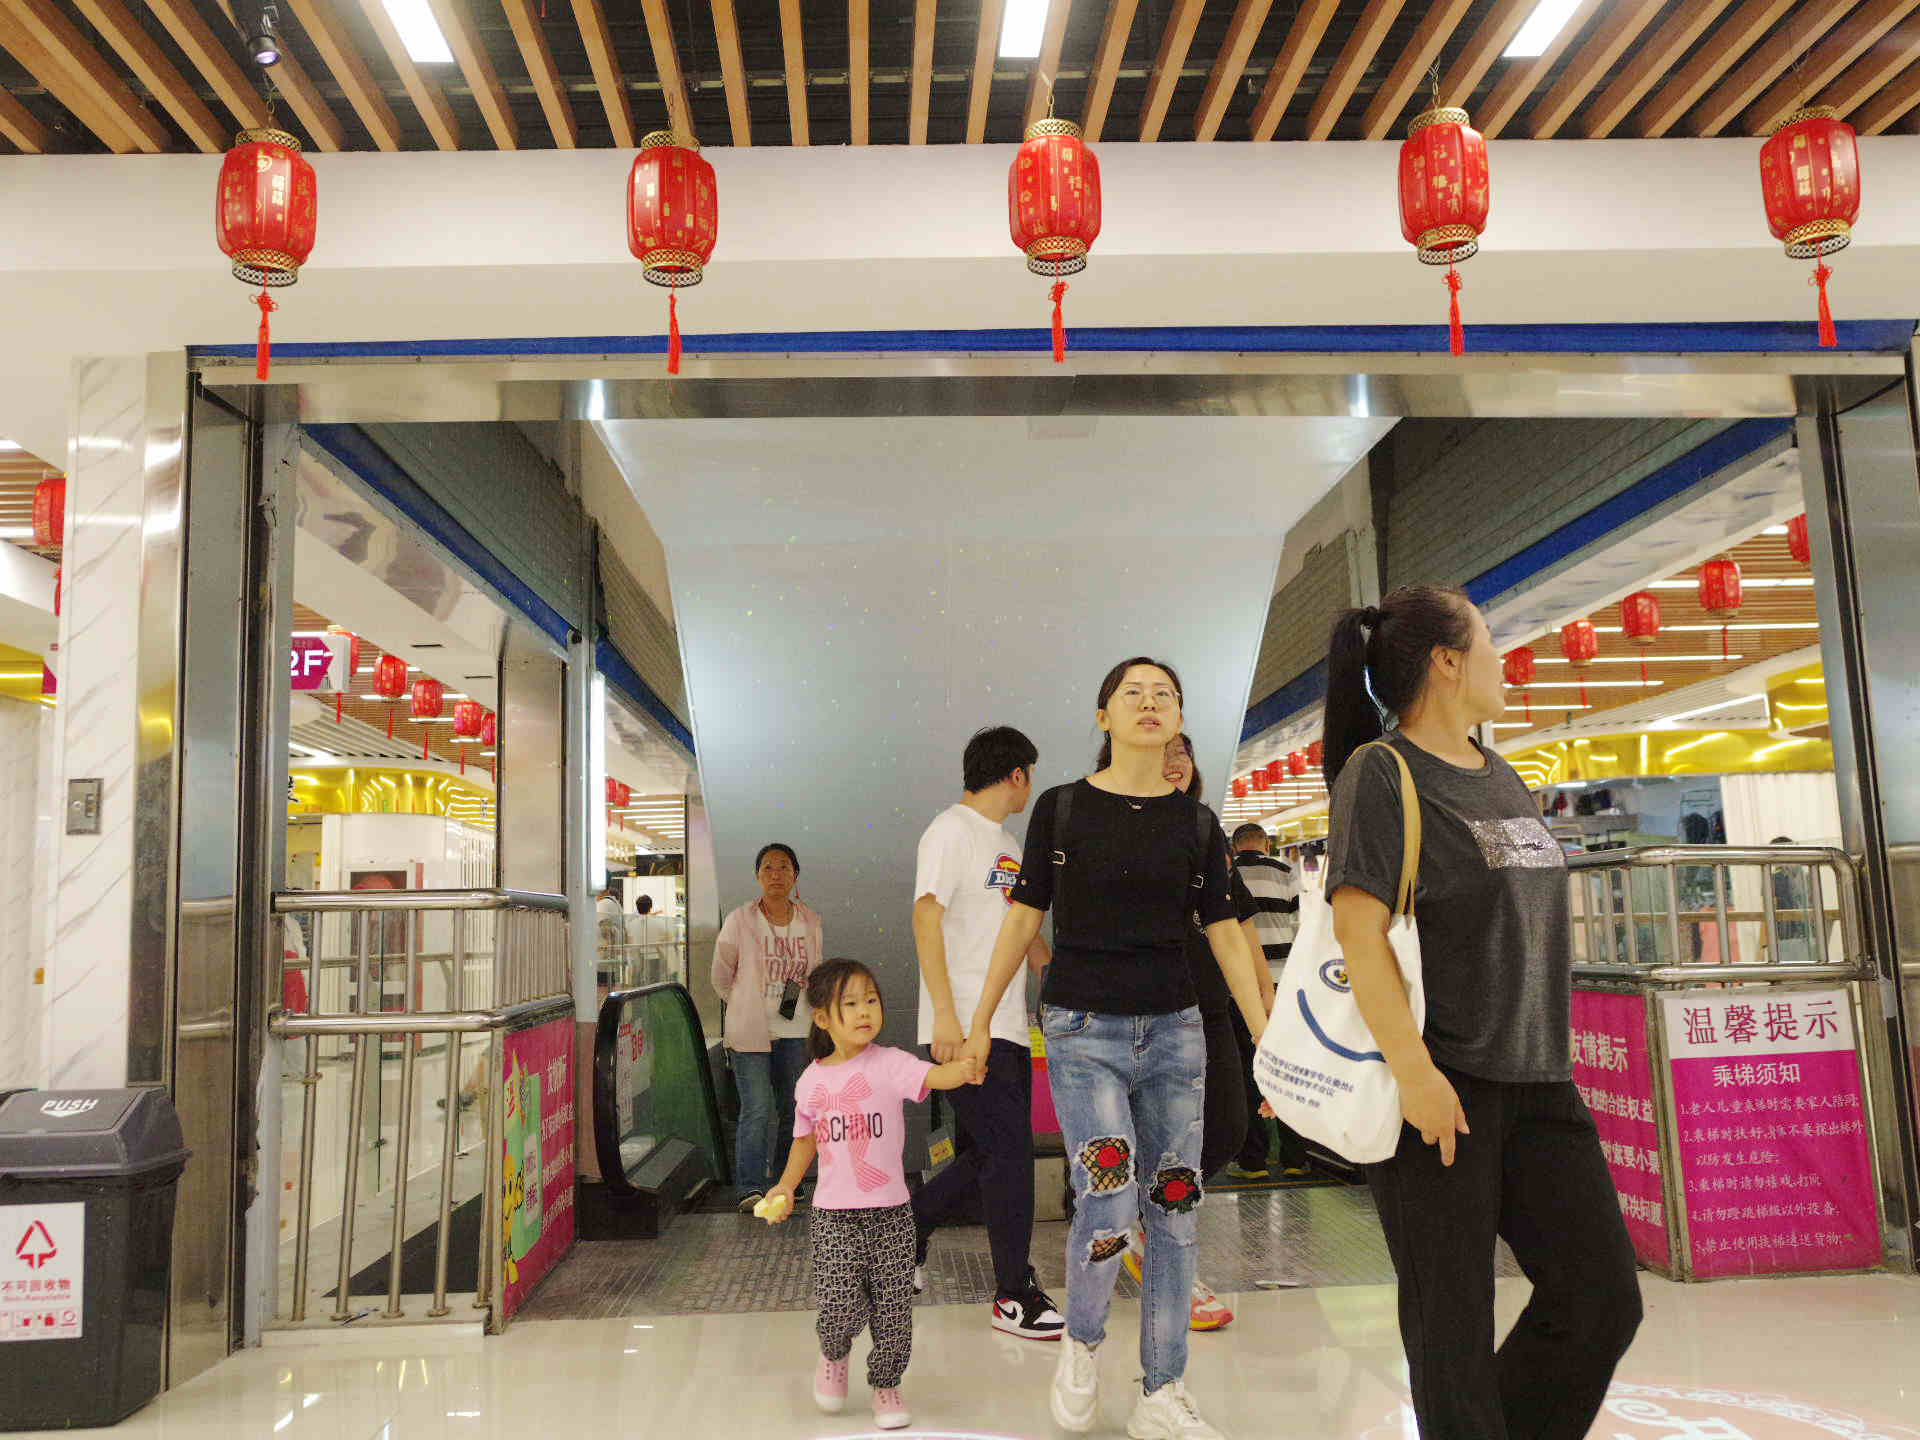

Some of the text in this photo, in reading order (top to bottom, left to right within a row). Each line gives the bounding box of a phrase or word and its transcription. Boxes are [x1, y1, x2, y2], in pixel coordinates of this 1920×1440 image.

[765, 936, 808, 960] LOVE
[1683, 1001, 1838, 1044] 温馨提示
[1712, 1061, 1801, 1087] 乘梯须知
[41, 1099, 98, 1112] PUSH
